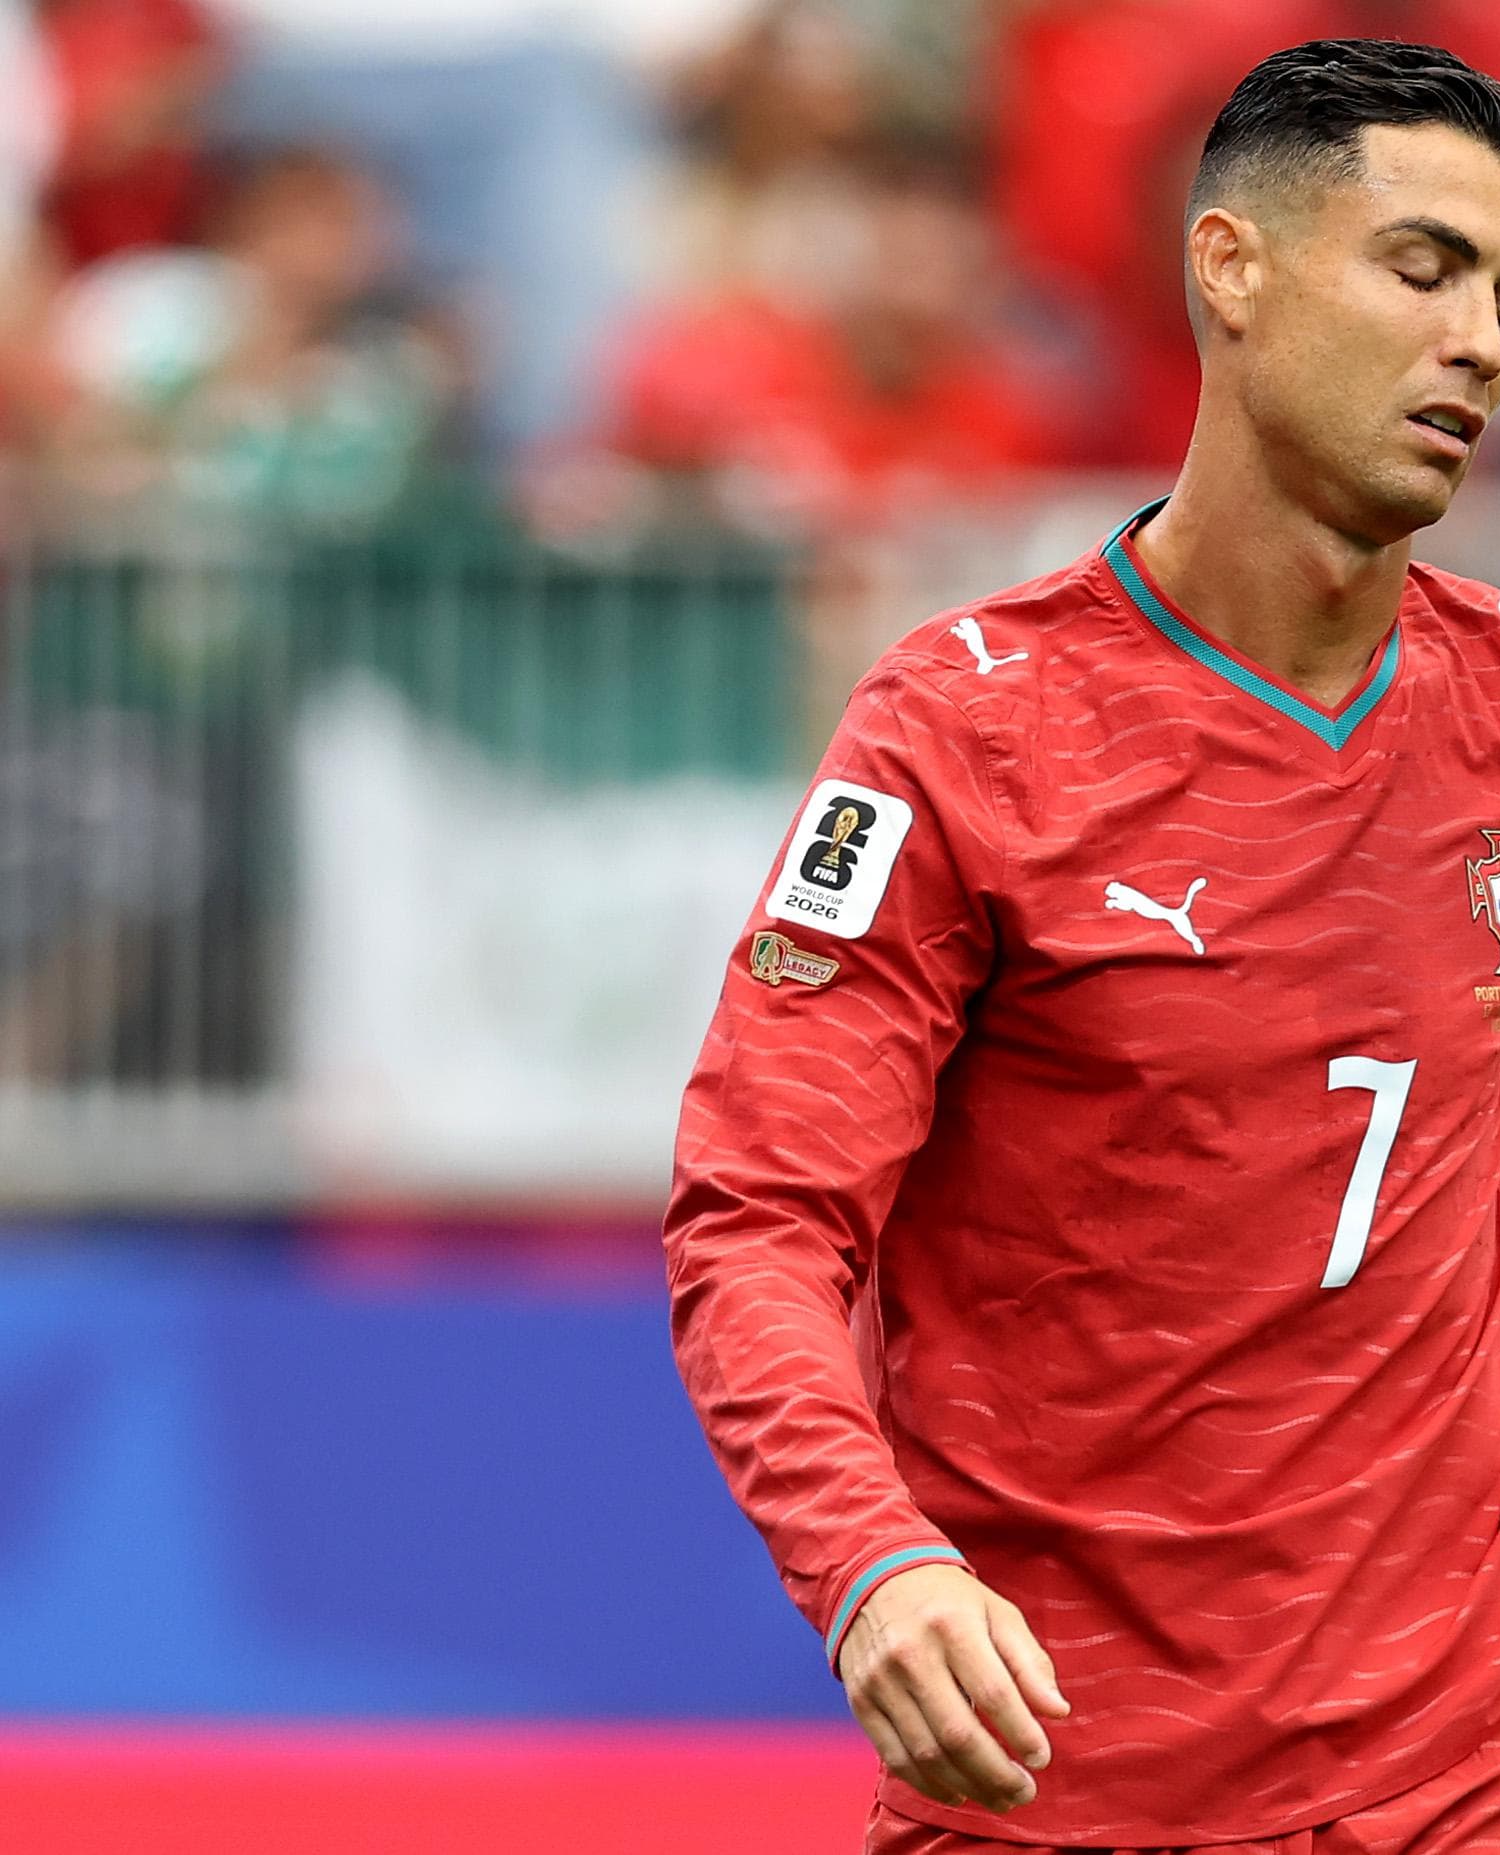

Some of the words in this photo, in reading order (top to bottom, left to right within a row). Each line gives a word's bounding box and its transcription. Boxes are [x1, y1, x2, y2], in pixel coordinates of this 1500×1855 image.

[812, 865, 838, 884] FIFA
[791, 883, 825, 901] WORLD
[825, 894, 844, 905] CUP
[785, 894, 840, 920] 2026
[786, 958, 827, 977] LEGACY
[1320, 1056, 1418, 1288] 7
